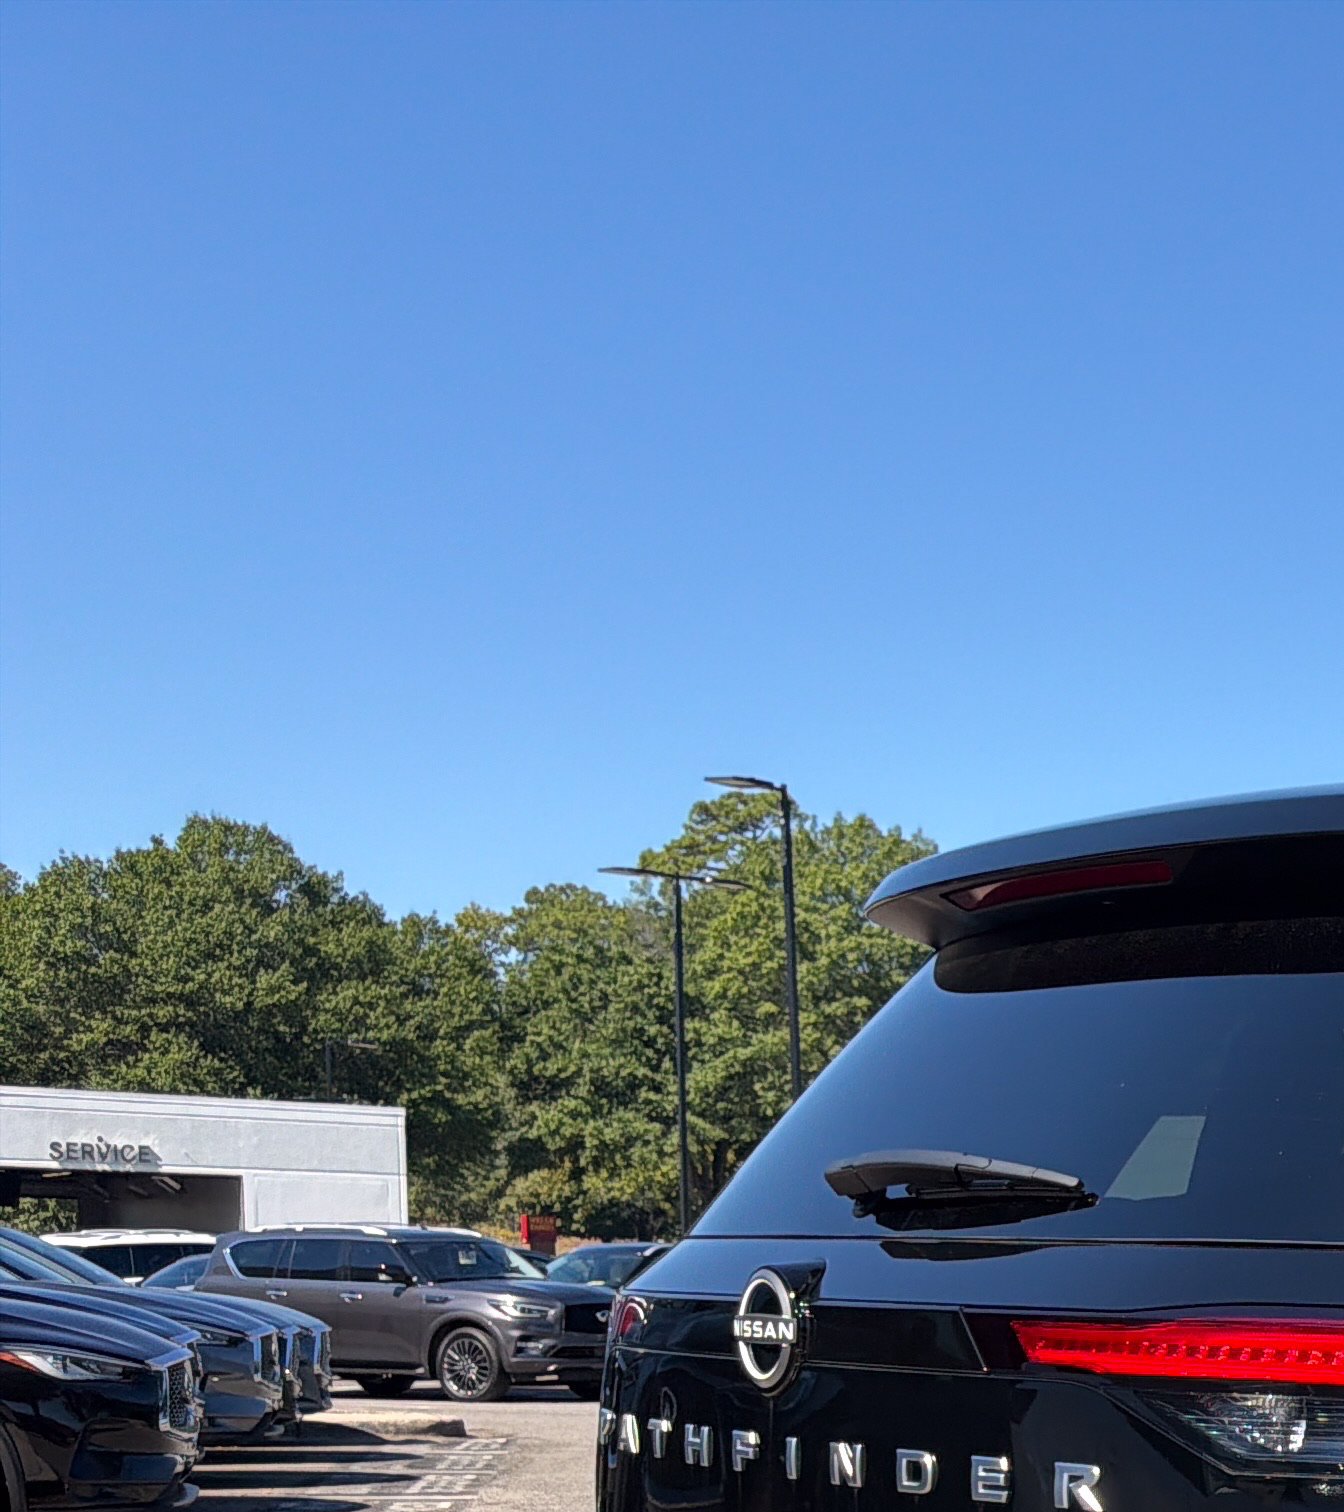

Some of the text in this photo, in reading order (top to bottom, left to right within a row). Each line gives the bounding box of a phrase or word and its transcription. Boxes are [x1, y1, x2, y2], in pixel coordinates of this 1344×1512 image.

[48, 1141, 154, 1164] SERVICE
[733, 1315, 797, 1344] NISSAN
[599, 1407, 1105, 1512] PATHFINDER
